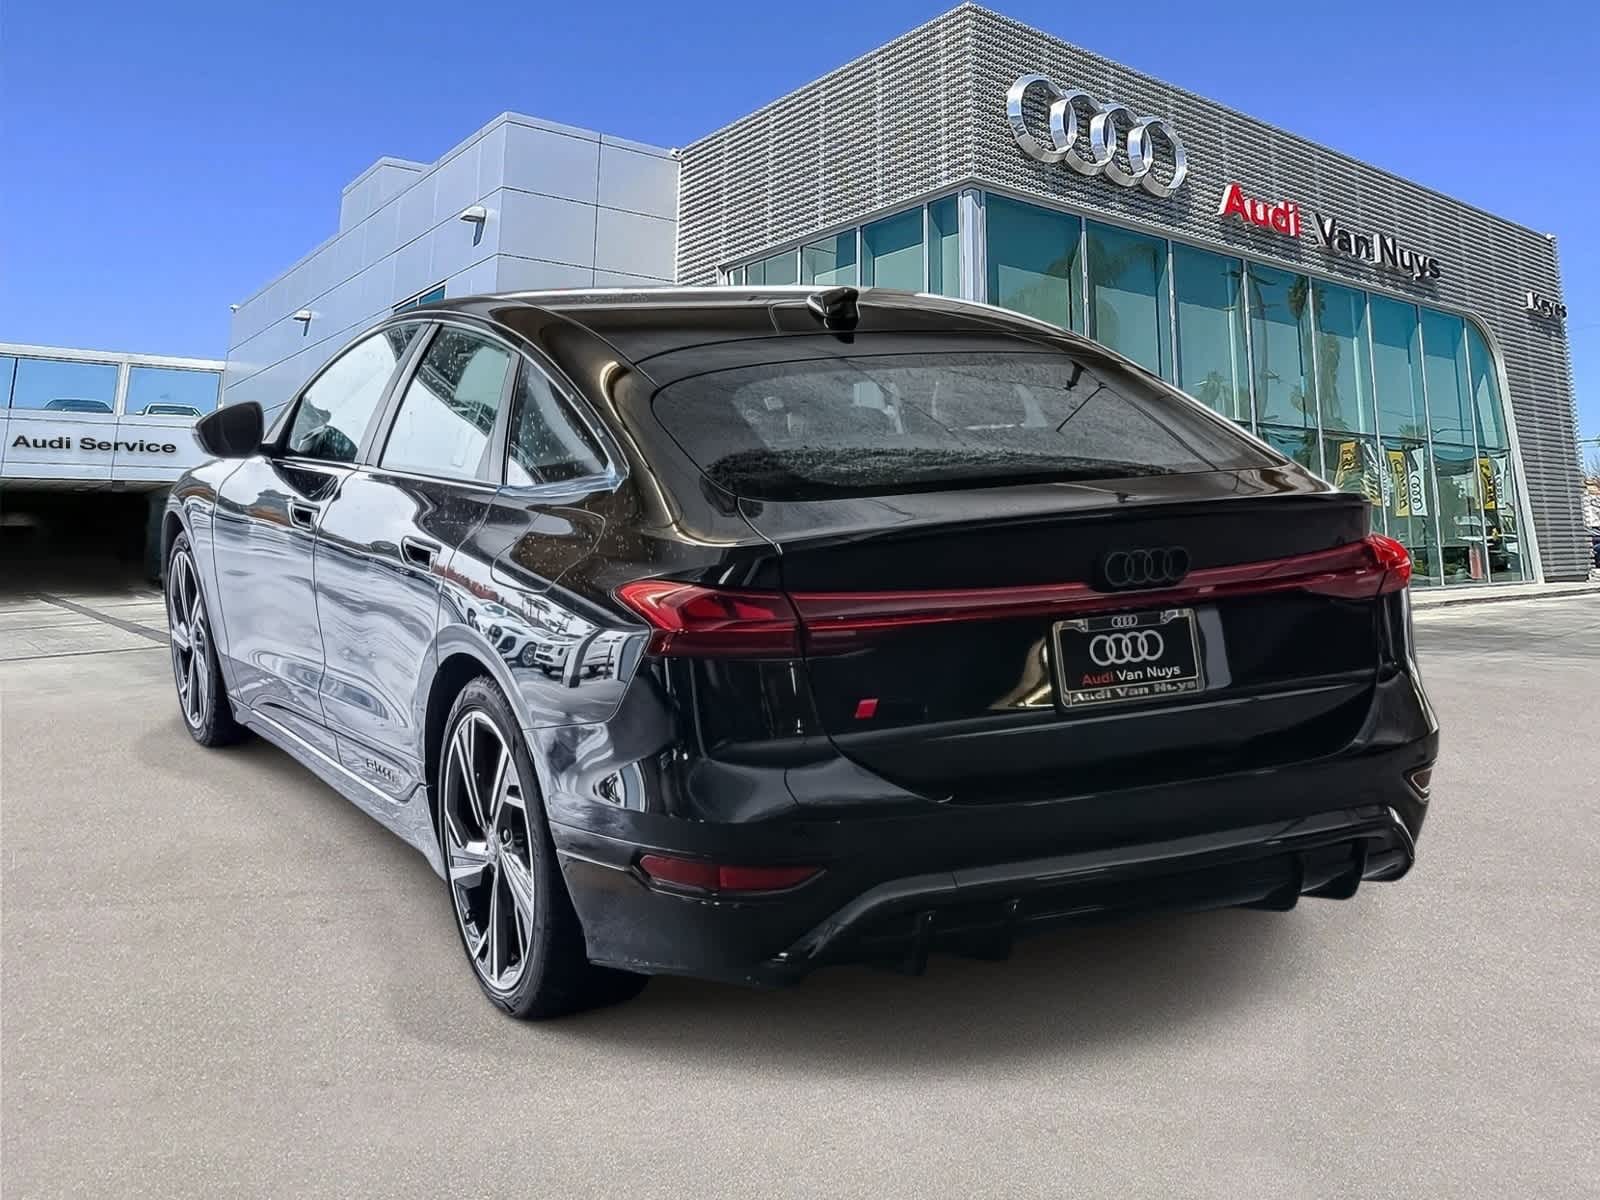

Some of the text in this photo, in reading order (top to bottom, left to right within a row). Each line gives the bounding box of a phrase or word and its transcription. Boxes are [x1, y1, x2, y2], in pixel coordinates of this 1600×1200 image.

[1217, 183, 1441, 281] Audi Van Nuys
[12, 435, 177, 454] Audi Service
[1081, 665, 1181, 685] Audi Van Nuys
[1072, 689, 1112, 703] Audi
[1116, 686, 1149, 698] Van
